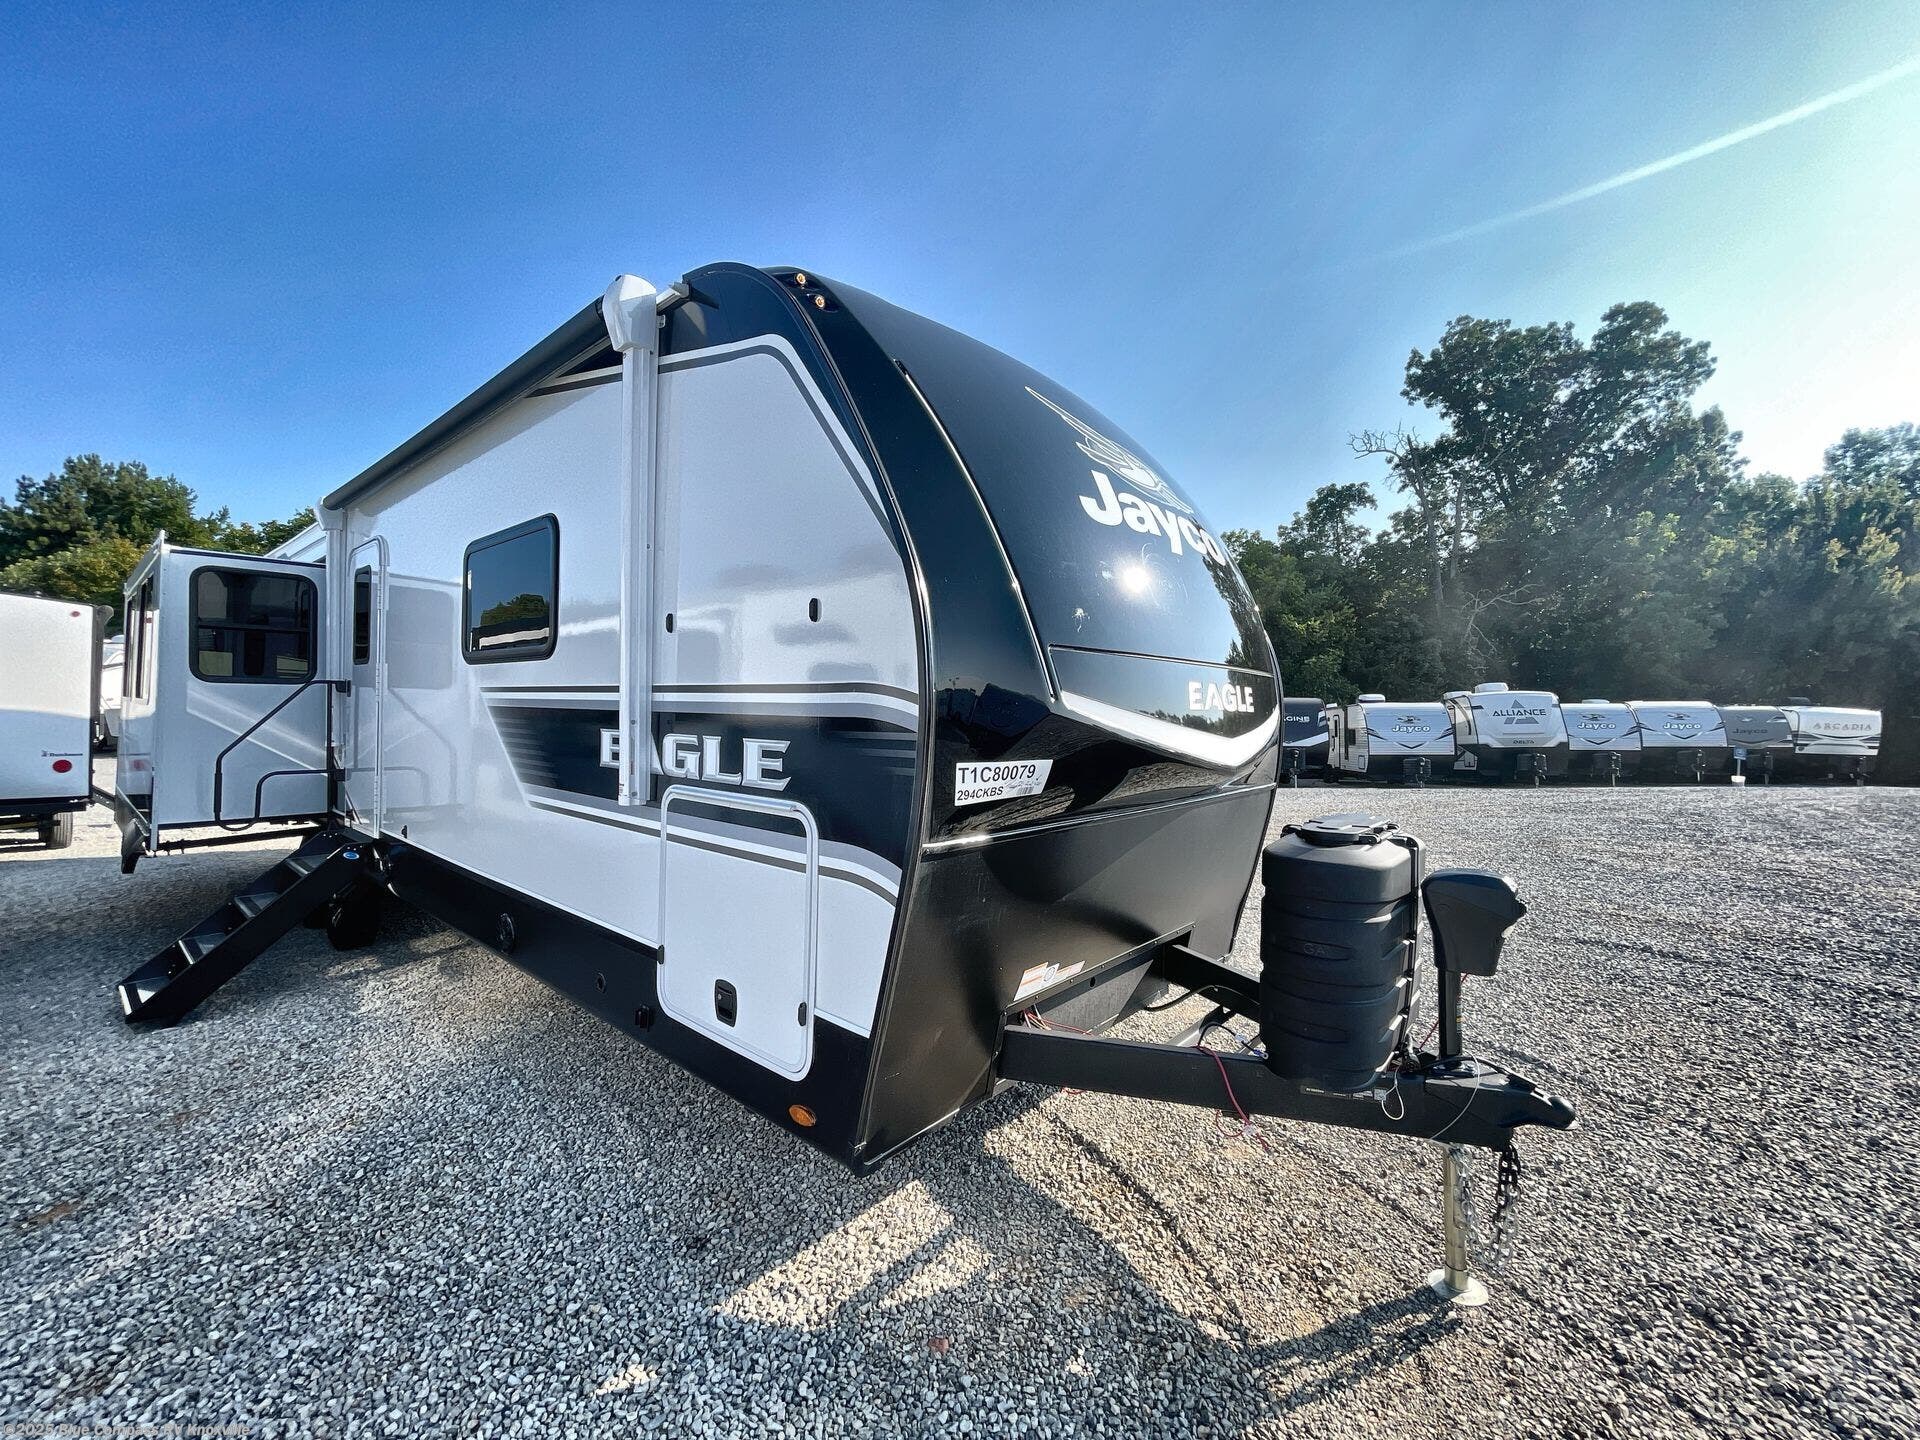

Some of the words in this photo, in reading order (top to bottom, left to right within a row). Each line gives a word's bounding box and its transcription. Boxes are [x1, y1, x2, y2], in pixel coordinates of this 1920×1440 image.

[1079, 470, 1226, 566] Jayco
[1189, 681, 1255, 713] EAGLE
[1492, 709, 1546, 717] ALLIANCE
[1391, 724, 1431, 734] Jayco
[1577, 722, 1616, 730] Jayco
[1663, 722, 1701, 730] Jayco
[1813, 722, 1872, 731] ARCADIA
[958, 764, 1036, 783] T1C80079
[957, 786, 1004, 801] 294CKBS
